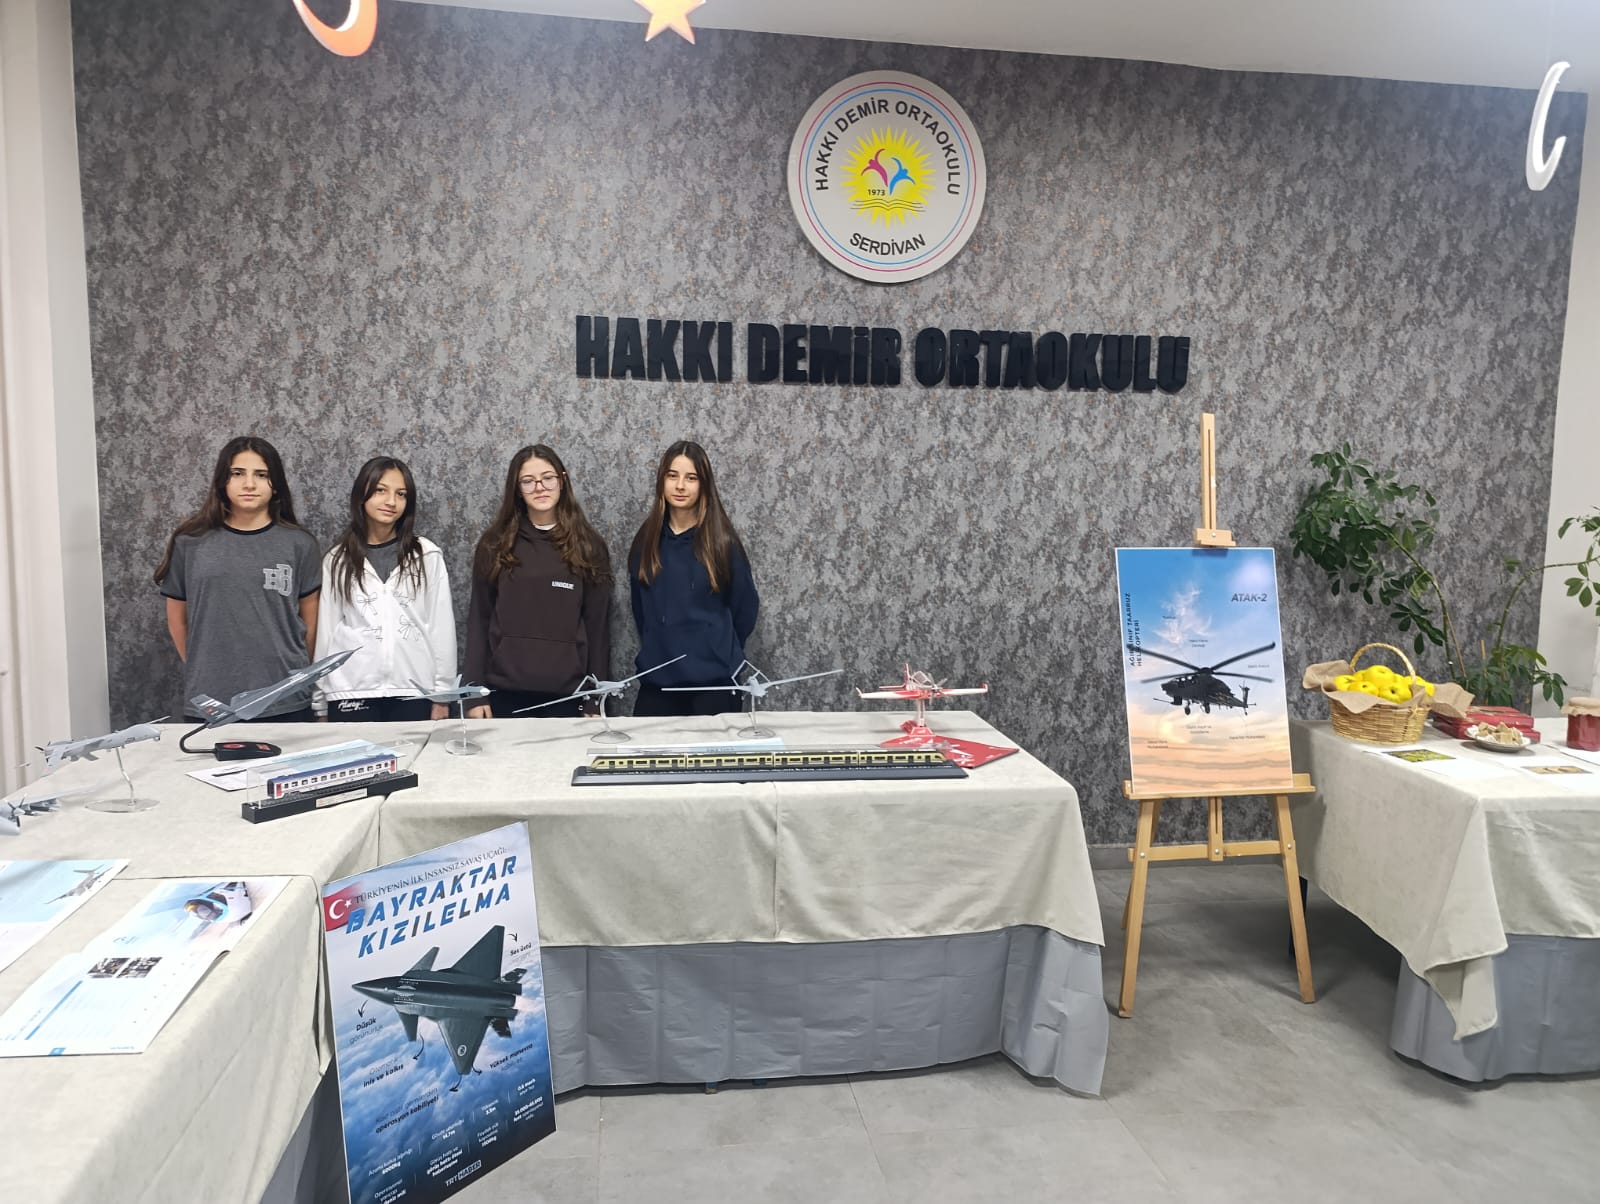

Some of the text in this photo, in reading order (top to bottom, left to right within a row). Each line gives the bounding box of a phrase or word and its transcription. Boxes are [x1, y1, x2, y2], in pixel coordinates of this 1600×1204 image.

[816, 96, 961, 195] HAKKI DEMİR ORTAOKULU
[867, 189, 886, 197] 1973
[850, 232, 927, 256] SERDİVAN
[575, 315, 733, 383] HAKKI
[914, 327, 1191, 394] ORTAOKULU
[1231, 592, 1268, 603] ATAK-2
[346, 856, 517, 934] BAYRAKTAR
[358, 883, 511, 959] KIZILELMA
[356, 1017, 377, 1031] Düşük
